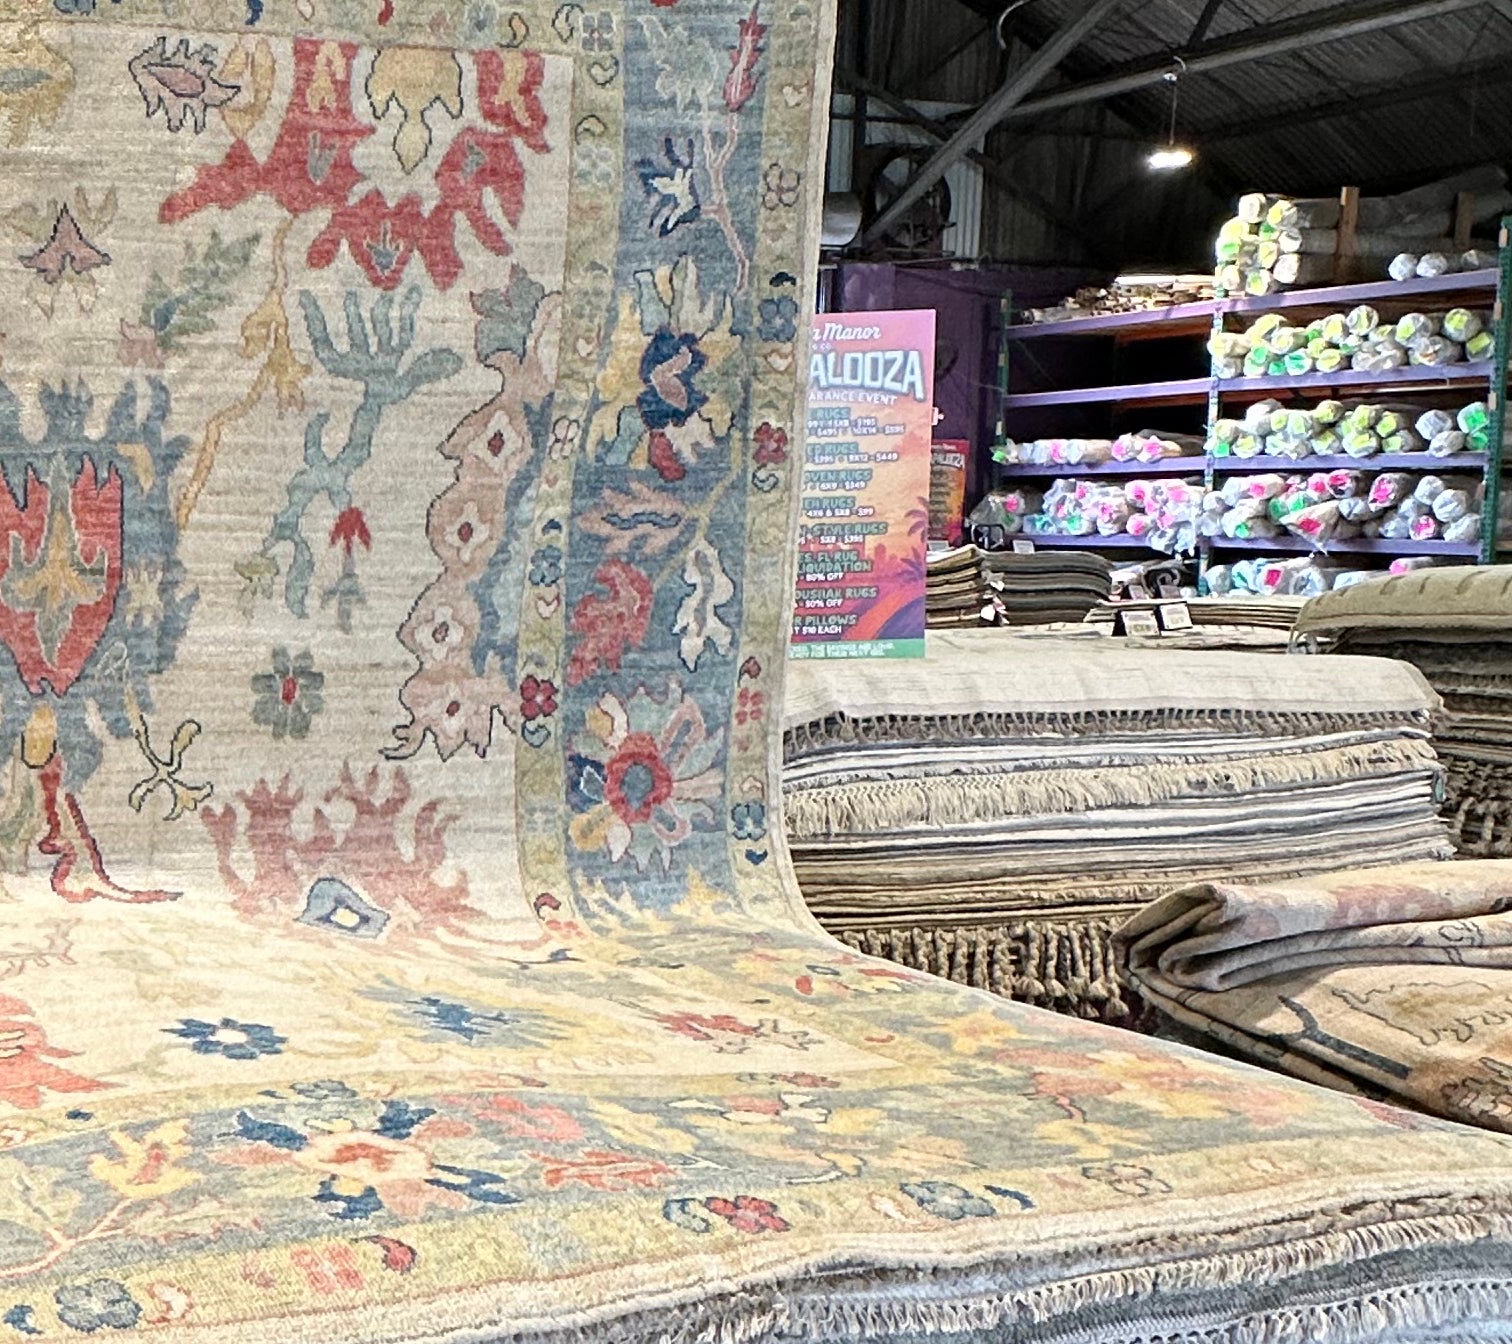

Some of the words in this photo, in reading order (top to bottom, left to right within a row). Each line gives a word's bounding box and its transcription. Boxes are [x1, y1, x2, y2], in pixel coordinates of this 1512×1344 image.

[822, 322, 882, 341] Manor
[858, 393, 898, 405] EVENT
[823, 442, 857, 454] RUGS
[838, 469, 871, 481] RUGS
[822, 497, 854, 509] RUGS
[854, 522, 886, 534] RUGS
[826, 572, 844, 581] OFF
[845, 587, 877, 598] RUGS
[826, 598, 843, 607] OFF
[805, 614, 857, 626] PILLOWS
[818, 625, 841, 634] EACH
